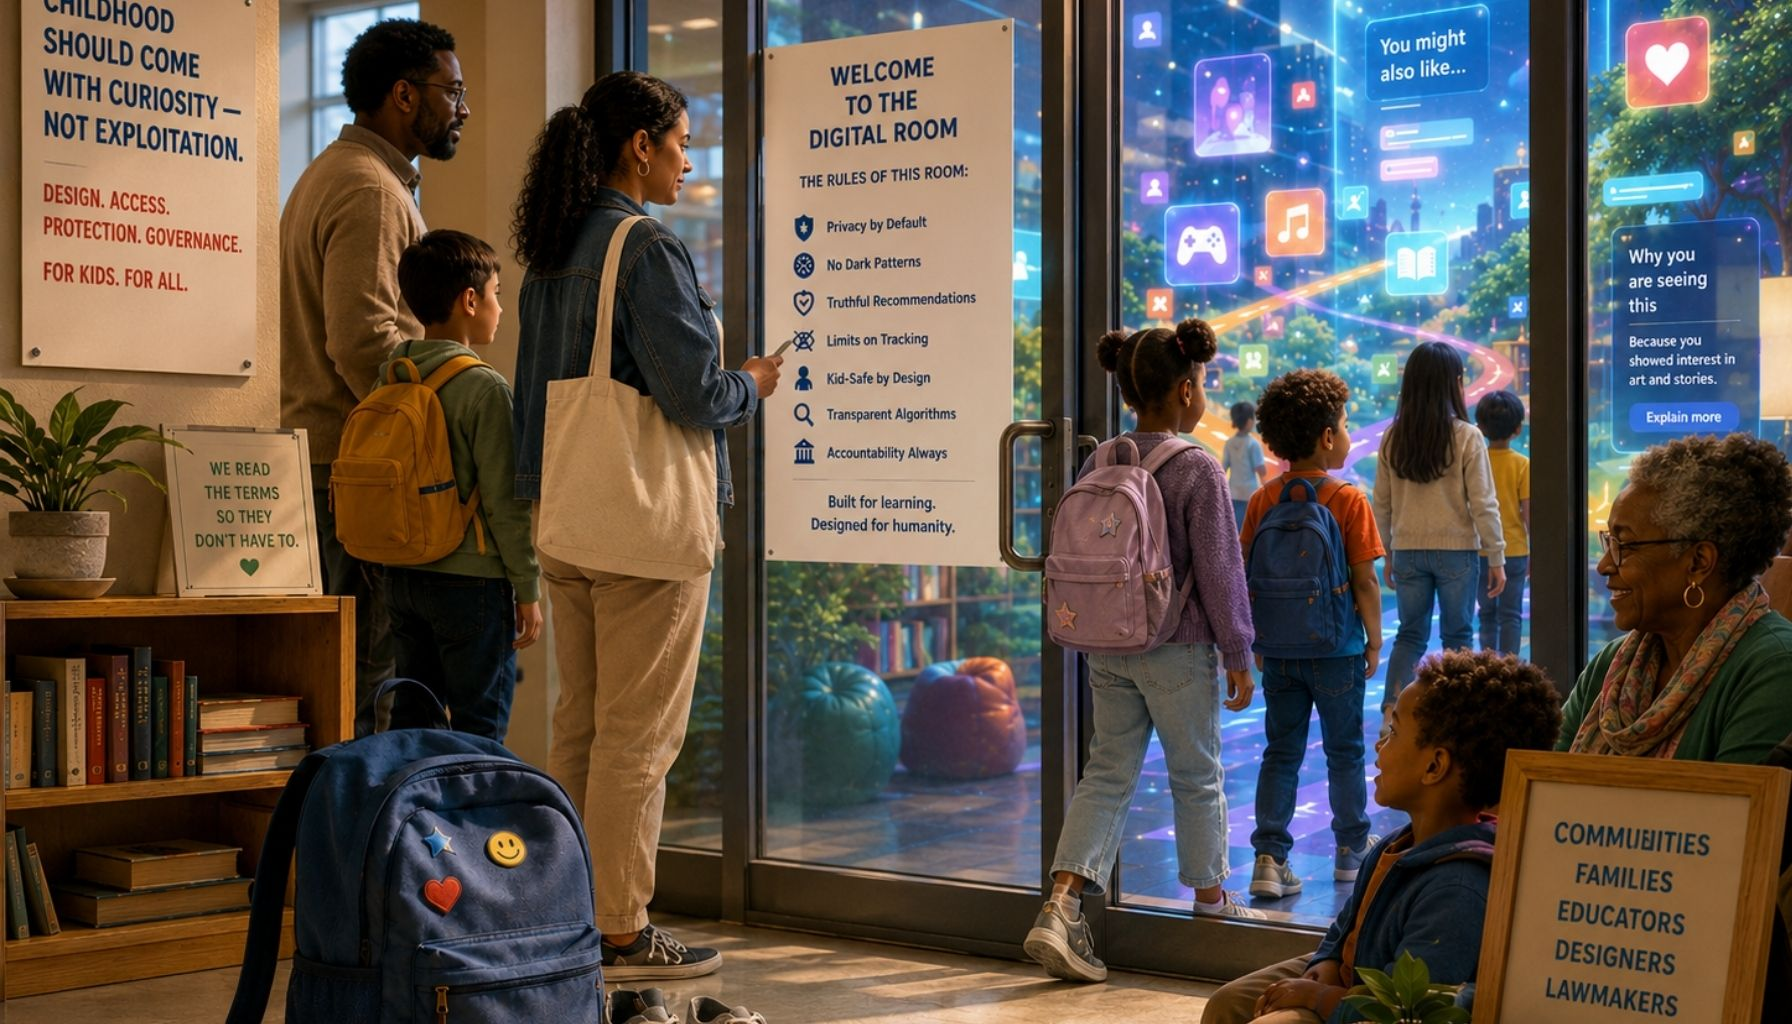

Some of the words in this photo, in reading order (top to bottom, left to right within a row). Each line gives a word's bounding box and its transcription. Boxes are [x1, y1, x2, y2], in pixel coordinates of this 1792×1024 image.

[1380, 38, 1410, 55] You
[1416, 29, 1465, 52] might
[44, 27, 133, 66] SHOULD
[141, 45, 199, 78] COME
[831, 57, 934, 86] WELCOME
[1381, 64, 1414, 82] also
[1421, 59, 1465, 77] like...
[44, 69, 100, 102] WITH
[109, 79, 218, 119] CURIOSITY
[846, 95, 872, 115] TO
[879, 90, 917, 112] THE
[45, 110, 88, 141] NOT
[96, 115, 243, 162] EXPLOITATION.
[810, 124, 887, 149] DIGITAL
[895, 117, 957, 142] ROOM
[800, 175, 823, 188] THE
[828, 171, 866, 186] RULES
[871, 170, 887, 183] OF
[891, 168, 920, 181] THIS
[925, 165, 968, 179] ROOM:
[44, 183, 104, 208] DESIGN.
[110, 191, 169, 215] ACCESS.
[827, 221, 867, 234] Privacy
[870, 219, 883, 233] by
[887, 216, 927, 229] Default
[44, 216, 141, 243] PROTECTION.
[146, 227, 242, 253] GOVERNANCE.
[827, 260, 842, 270] No
[846, 258, 871, 270] Dark
[875, 257, 921, 268] Patterns
[1629, 248, 1662, 267] Why
[1667, 251, 1694, 266] you
[44, 262, 73, 283] FOR
[80, 265, 119, 286] KIDS.
[125, 269, 153, 289] FOR
[158, 272, 187, 291] ALL.
[1629, 277, 1652, 288] are
[1657, 271, 1707, 289] seeing
[827, 296, 869, 308] Truthful
[873, 292, 976, 306] Recommendations
[1629, 297, 1656, 312] this
[827, 335, 860, 347] Limits
[863, 337, 877, 345] on
[881, 333, 928, 347] Tracking
[1630, 336, 1676, 347] Because
[1680, 337, 1701, 349] you
[1630, 354, 1673, 366] showed
[1677, 354, 1721, 365] interest
[1725, 353, 1735, 364] in
[827, 372, 873, 384] Kid-Safe
[877, 372, 889, 386] by
[893, 372, 930, 386] Design
[1629, 375, 1646, 385] art
[1649, 373, 1670, 385] and
[1674, 372, 1717, 384] stories.
[827, 409, 892, 422] Transparent
[895, 408, 956, 423] Algorithms
[1647, 411, 1688, 425] Explain
[1692, 414, 1721, 422] more
[827, 447, 904, 461] Accountability
[908, 447, 947, 461] Always
[210, 462, 230, 475] WE
[236, 462, 270, 476] READ
[205, 486, 231, 499] THE
[234, 486, 279, 499] TERMS
[829, 495, 856, 508] Built
[860, 495, 878, 508] for
[882, 496, 935, 513] learning.
[217, 510, 234, 523] SO
[238, 510, 271, 523] THEY
[812, 517, 867, 534] Designed
[871, 518, 889, 531] for
[893, 519, 955, 536] humanity.
[195, 534, 235, 547] DON'T
[240, 534, 274, 547] HAVE
[277, 534, 298, 547] TO.
[1576, 863, 1672, 893] FAMILIES
[1558, 900, 1685, 935] EDUCATORS
[1555, 940, 1675, 975] DESIGNERS
[1546, 978, 1678, 1017] LAWMAKERS
